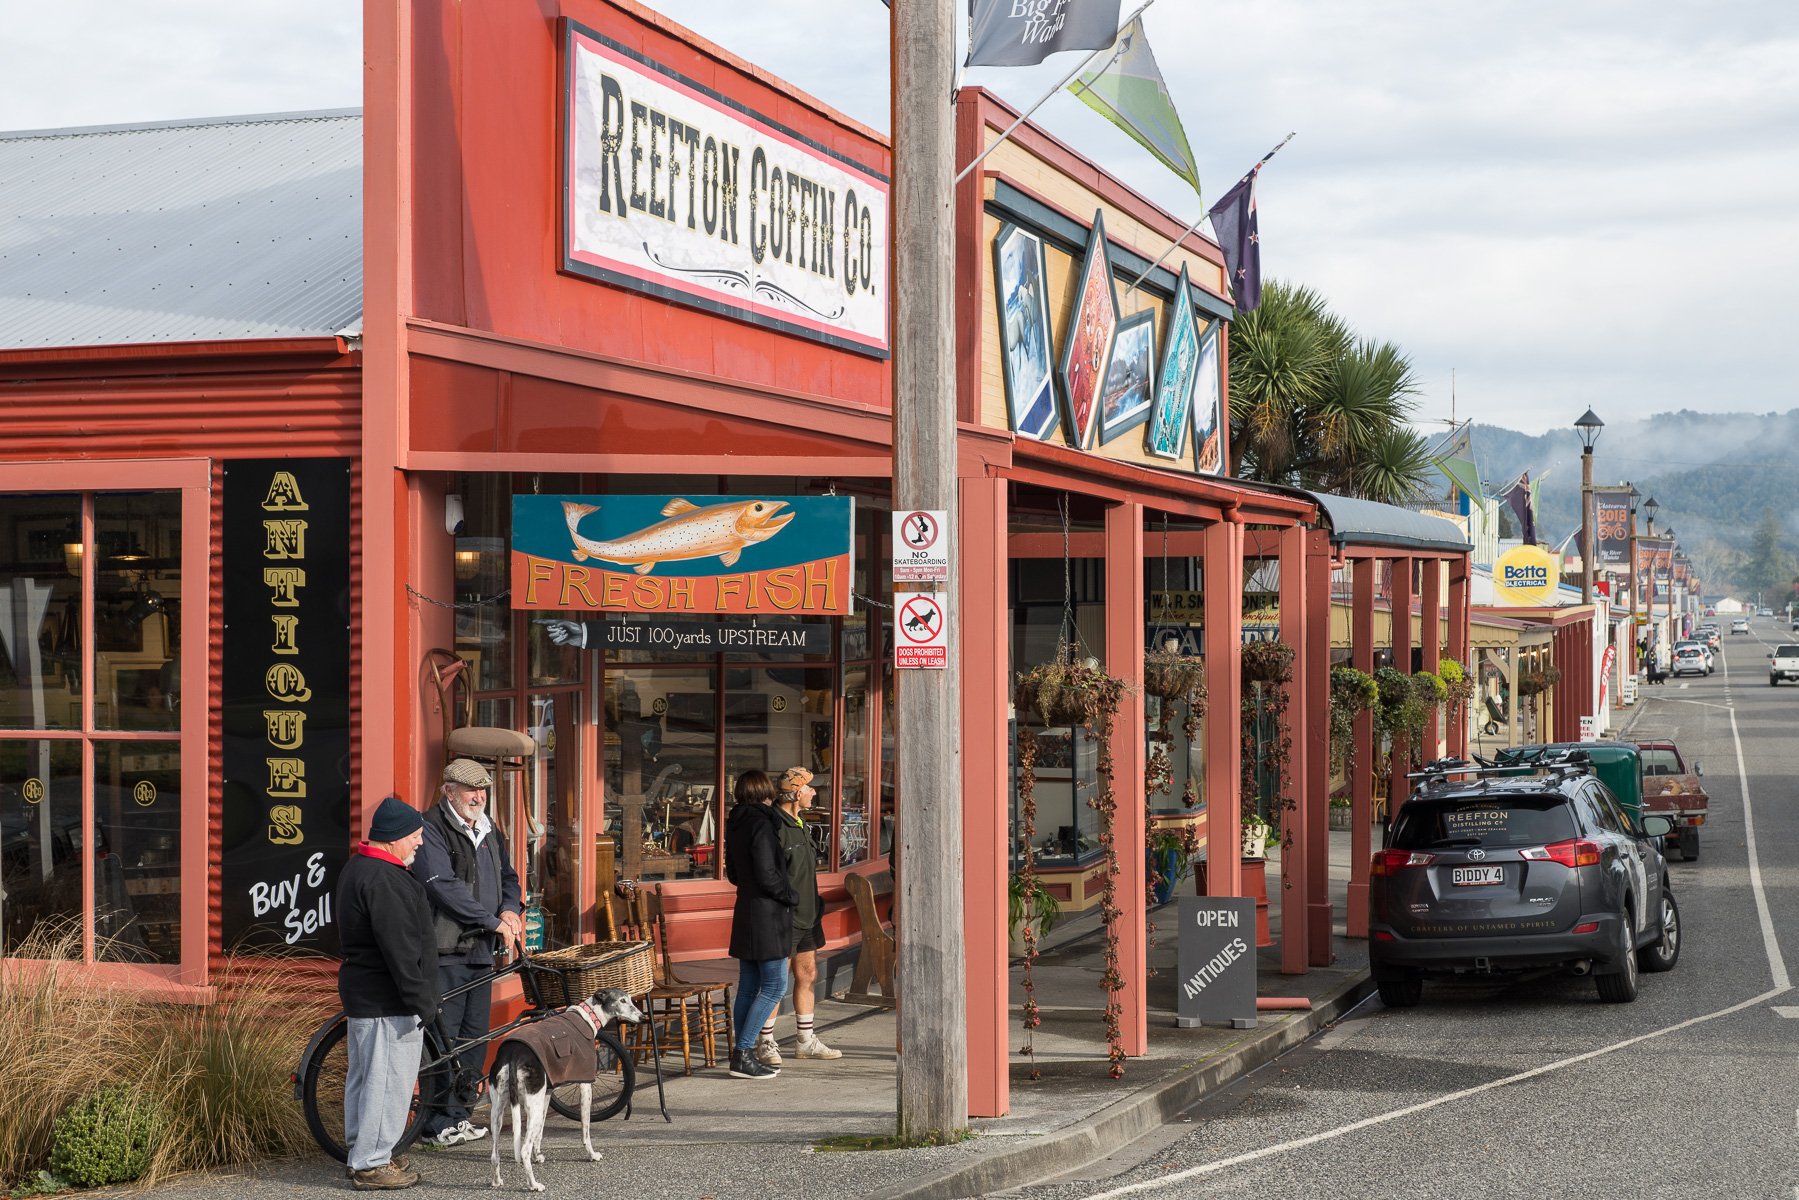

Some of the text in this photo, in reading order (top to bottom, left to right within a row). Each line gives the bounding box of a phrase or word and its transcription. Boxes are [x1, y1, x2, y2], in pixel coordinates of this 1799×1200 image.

[599, 73, 740, 245] REEFTON
[750, 146, 835, 280] COFFIN
[1504, 565, 1547, 579] Betta
[525, 555, 838, 610] FRESH FISH
[607, 626, 640, 643] JUST
[718, 628, 807, 647] UPSTREAM
[261, 471, 311, 845] ANTIQUES
[898, 648, 944, 656] DOGS PROHIBITED
[898, 657, 945, 665] UNLESS ON LEASH
[1601, 648, 1616, 685] OPEN
[1448, 811, 1508, 822] REEFTON
[1452, 820, 1491, 828] DISTILLING
[1454, 868, 1502, 882] BIDDY 4
[248, 852, 326, 918] Buy &
[284, 891, 332, 945] Sell
[1196, 910, 1239, 928] OPEN
[1410, 925, 1453, 933] CRAFTERS
[1472, 923, 1516, 931] UNTAMED
[1520, 920, 1556, 928] SPIRITS
[1183, 937, 1248, 1000] ANTIQUES
